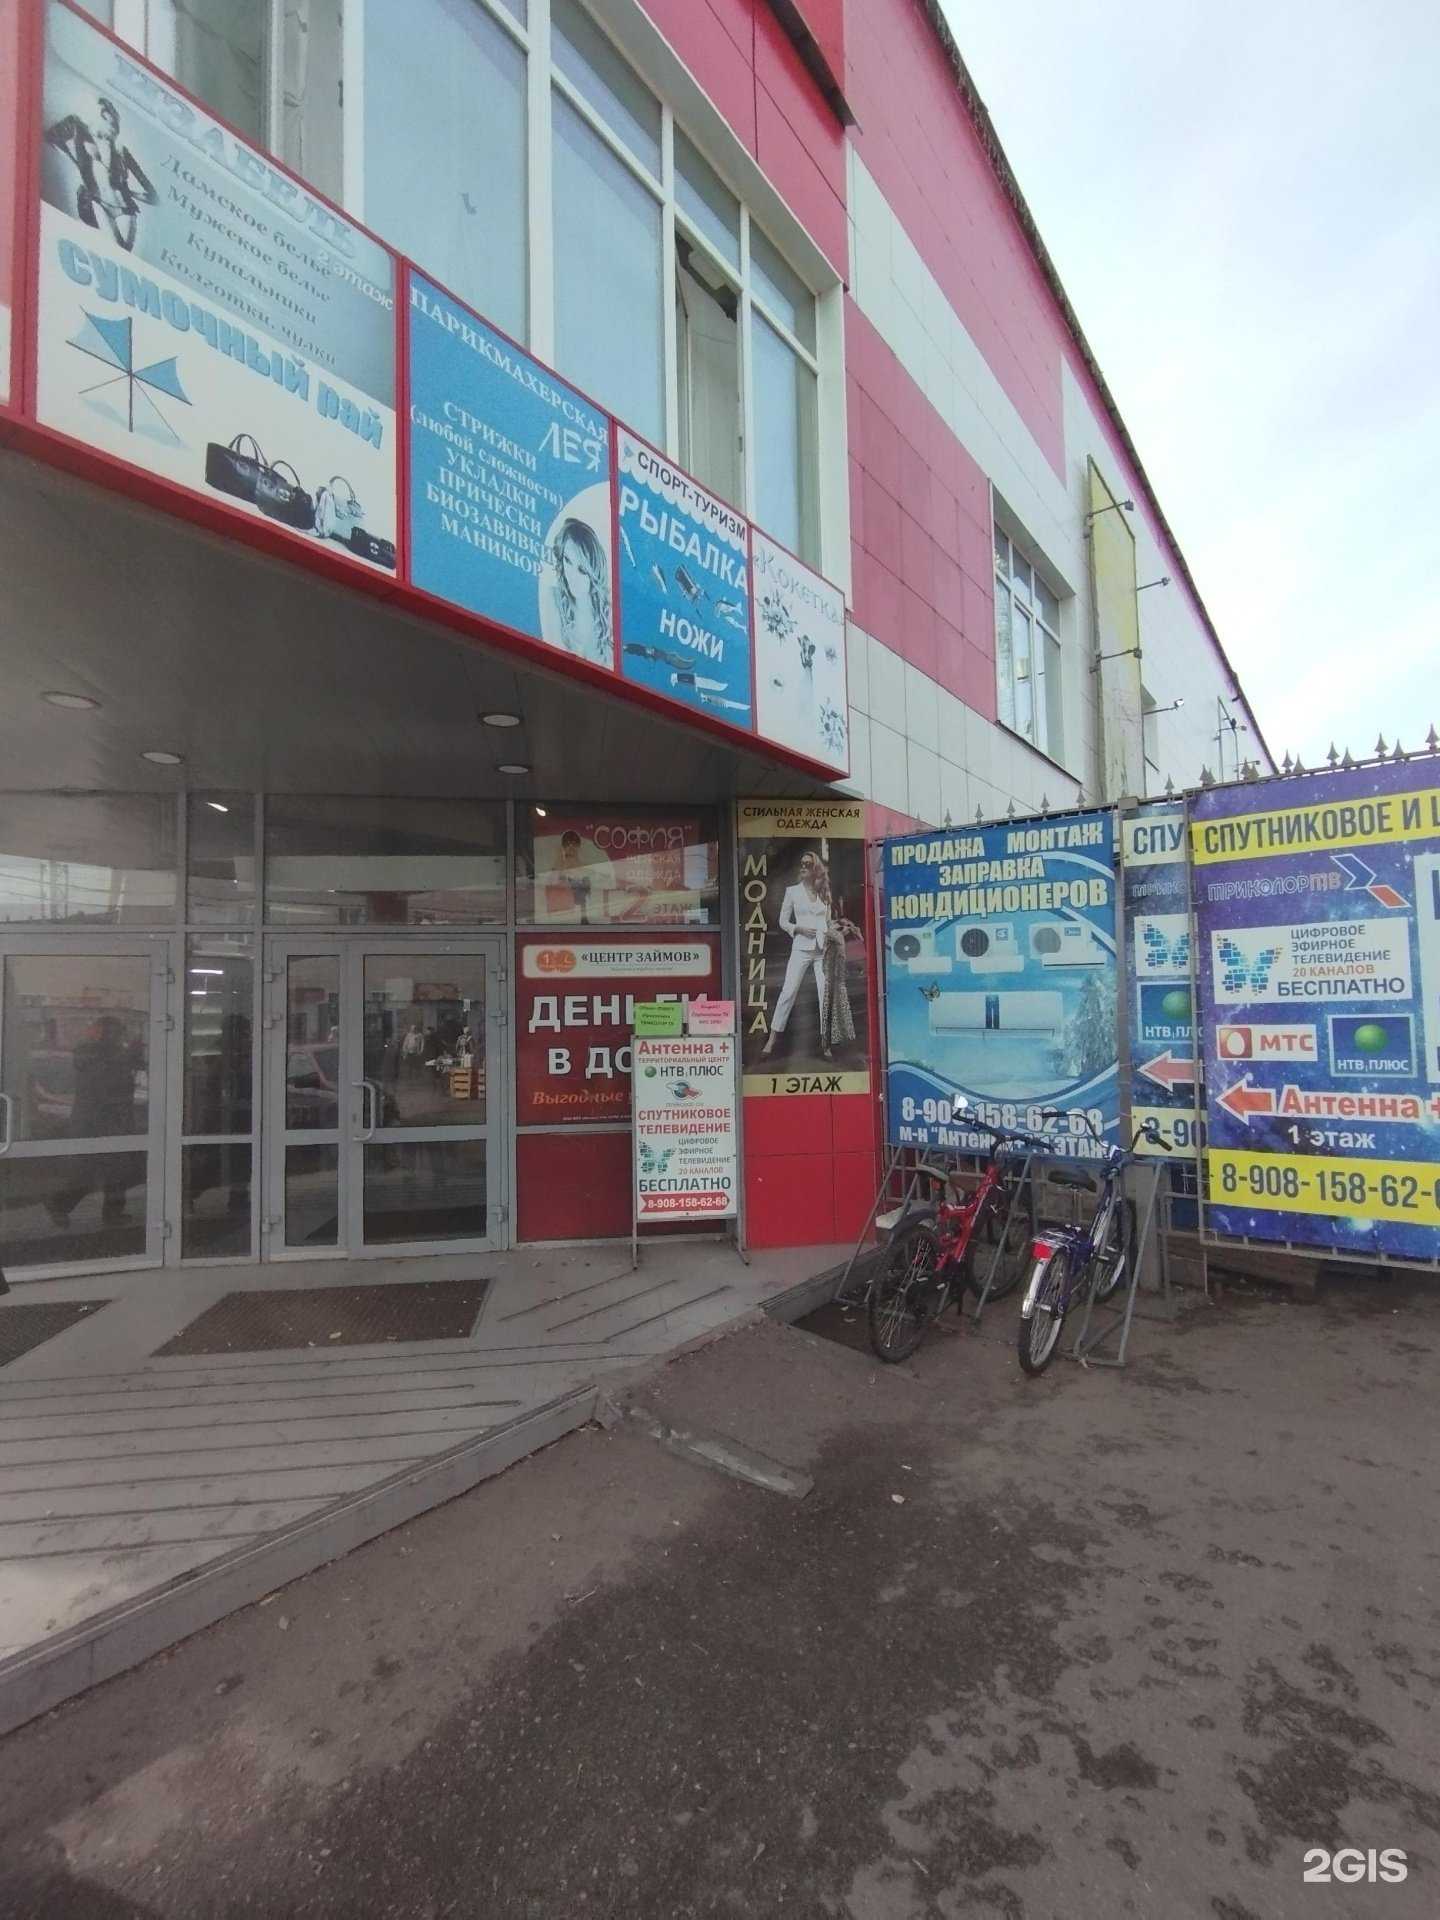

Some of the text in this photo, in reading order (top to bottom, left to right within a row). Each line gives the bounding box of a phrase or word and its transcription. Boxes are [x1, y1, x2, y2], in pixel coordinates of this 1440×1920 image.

[160, 154, 268, 235] Дамское
[168, 185, 331, 303] Мужское белье
[186, 232, 318, 326] Купальники
[333, 263, 393, 312] этаж
[410, 283, 609, 447] ПАРИКМАХЕРСКАЯ
[443, 401, 537, 472] СТРИЖКИ
[538, 421, 602, 473] ЛЕЯ
[410, 404, 564, 510] (любой сложности)
[444, 447, 537, 513] УКЛАДКИ
[637, 451, 746, 542] СПОРТ-ТУРИЗМ
[439, 466, 542, 538] ПРИЧЕСКИ
[426, 483, 556, 566] БИОЗАВИВКИ
[619, 486, 749, 597] РЫБАЛКА
[440, 513, 543, 579] МАНИКЮР
[659, 608, 724, 663] НОЖИ
[743, 806, 860, 819] СТИЛЬНАЯ ЖЕНСКАЯ
[776, 819, 828, 830] ОДЕЖДА
[1204, 801, 1393, 854] СПУТНИКОВОЕ
[1402, 798, 1421, 830] И
[891, 821, 1103, 866] ПРОДАЖА МОНТАЖ
[939, 856, 1045, 887] ЗАПРАВКА
[891, 878, 1108, 921] КОНДИЦИОНЕРОВ
[743, 854, 769, 1034] МОДНИЦА
[1290, 925, 1366, 940] ЦИФРОВОЕ
[1291, 938, 1355, 953] ЭФИРНОЕ
[581, 952, 633, 965] «ЦЕНТР
[635, 949, 700, 963] ЗАЙМОВ»
[1292, 949, 1391, 965] ТЕЛЕВИДЕНИЕ
[1293, 964, 1375, 978] 20 КАНАЛОВ
[1277, 977, 1405, 998] БЕСПЛАТНО
[548, 1048, 571, 1075] В
[639, 1041, 714, 1054] Антенна
[1260, 1034, 1314, 1051] МТС
[532, 1088, 623, 1105] Выгодные
[771, 1076, 842, 1093] 1 ЭТАЖ
[1281, 1084, 1420, 1119] Антенна
[638, 1108, 731, 1120] СПУТНИКОВОЕ
[638, 1122, 731, 1135] ТЕЛЕВИДЕНИЕ
[1288, 1125, 1376, 1149] 1 этаж
[638, 1176, 731, 1192] БЕСПЛАТНО
